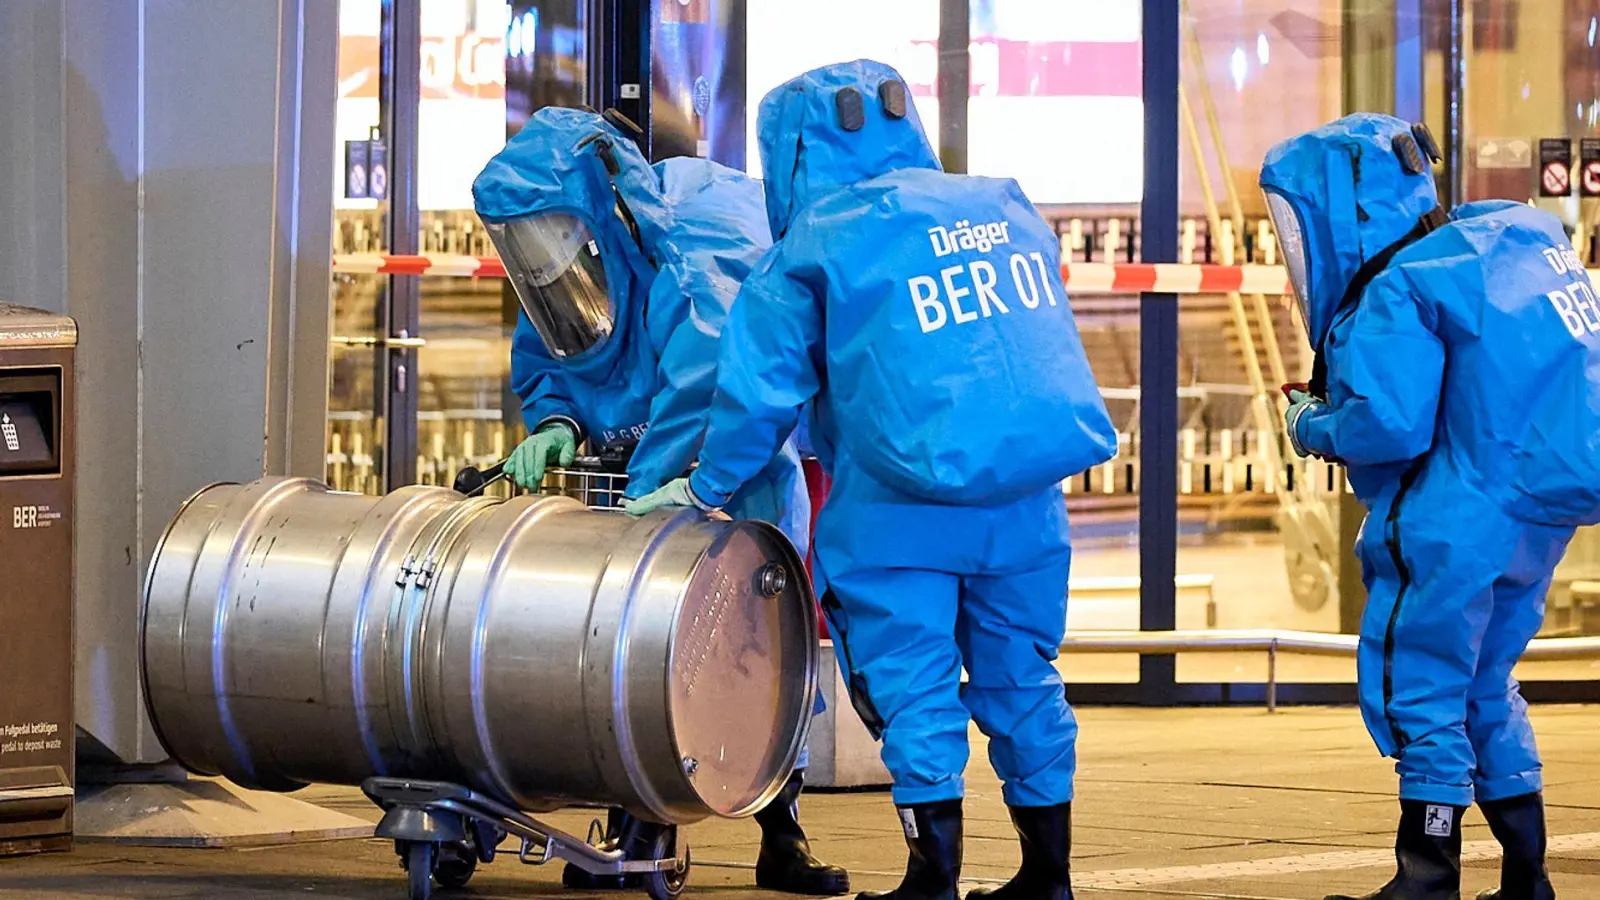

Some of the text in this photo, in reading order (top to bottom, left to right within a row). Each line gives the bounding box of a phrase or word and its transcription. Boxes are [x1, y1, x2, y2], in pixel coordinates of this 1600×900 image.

[928, 220, 1010, 257] Dräger
[908, 252, 1057, 333] BER 01
[13, 506, 37, 528] BER
